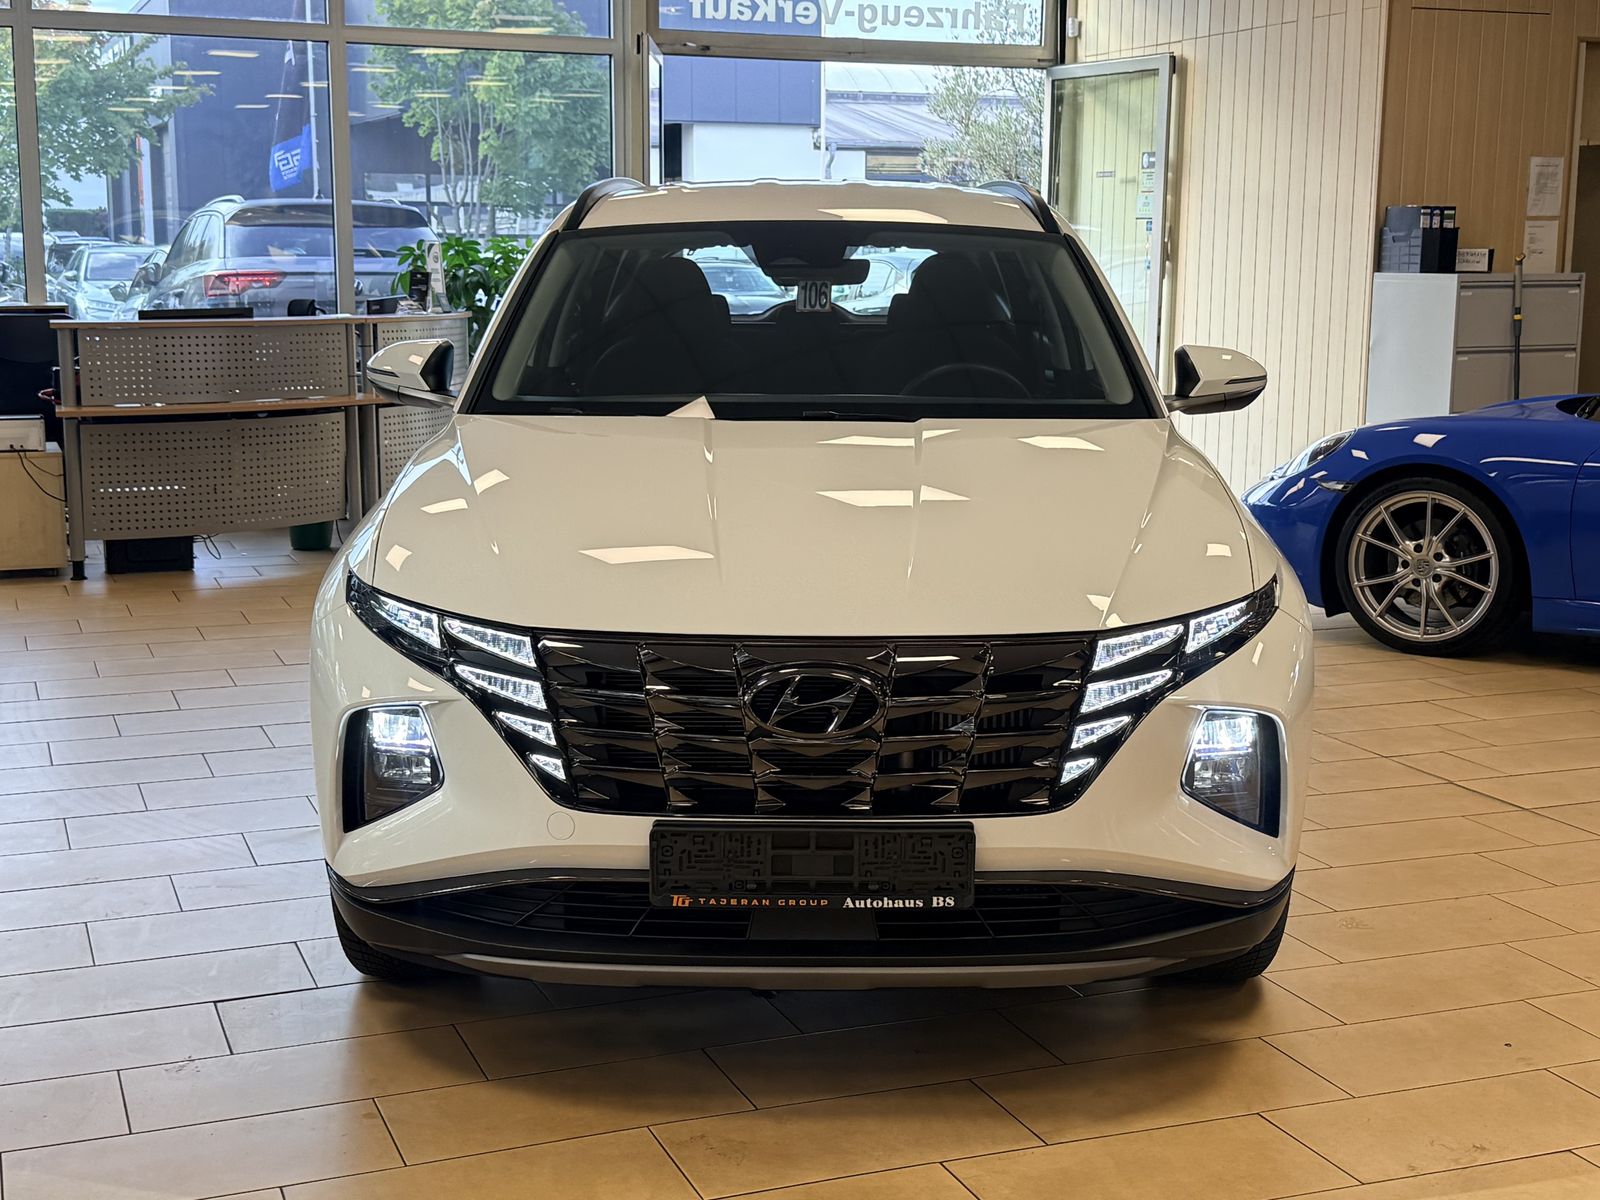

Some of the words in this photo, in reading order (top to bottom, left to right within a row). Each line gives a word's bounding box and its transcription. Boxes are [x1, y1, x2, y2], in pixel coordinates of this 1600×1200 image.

[801, 282, 829, 309] 106
[843, 897, 924, 909] Autohaus
[932, 896, 955, 908] B8
